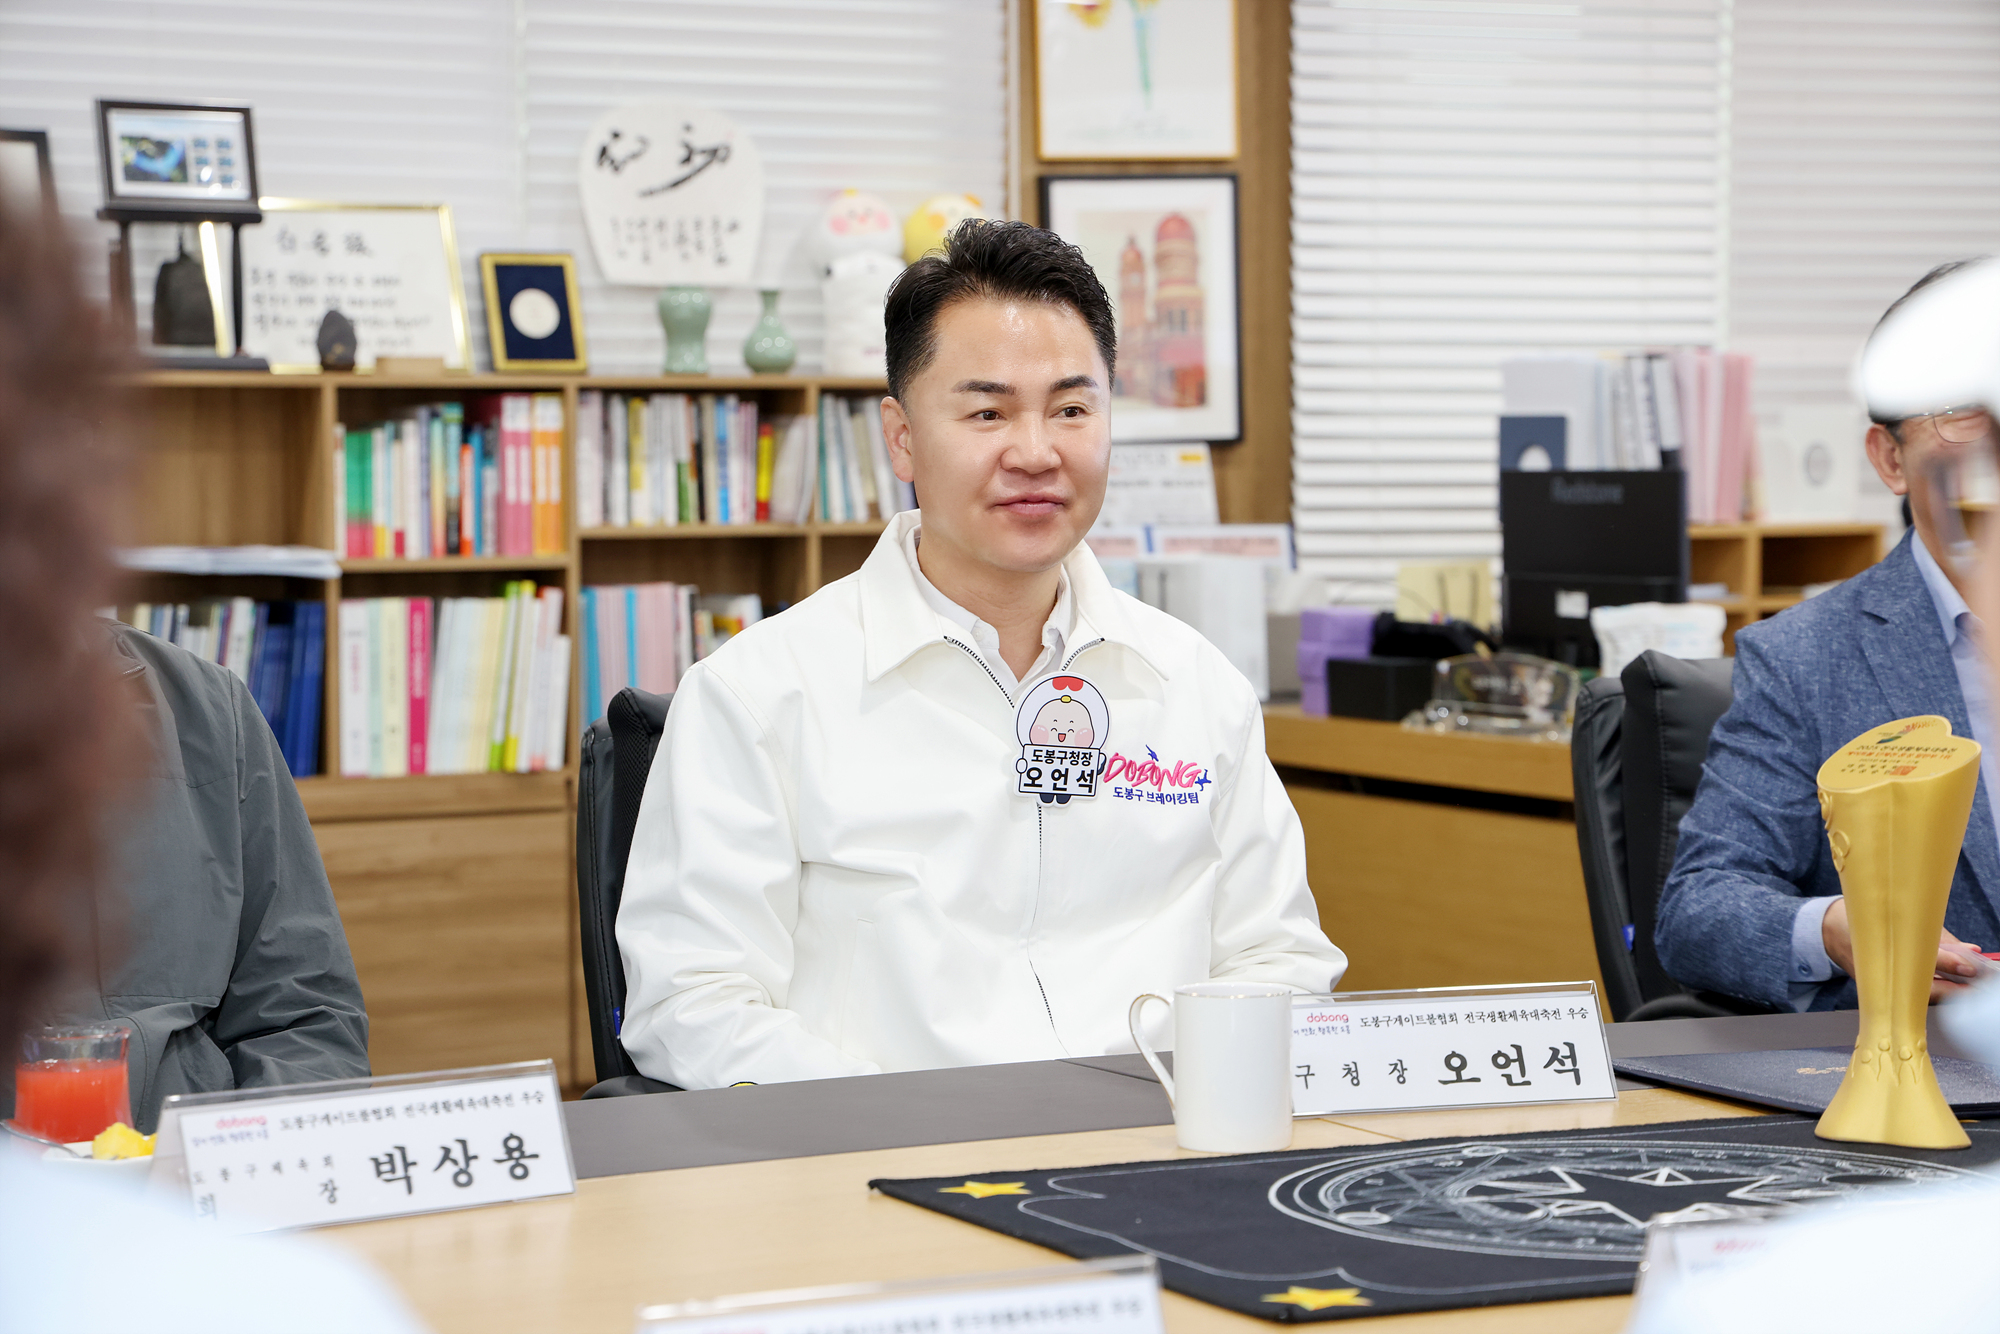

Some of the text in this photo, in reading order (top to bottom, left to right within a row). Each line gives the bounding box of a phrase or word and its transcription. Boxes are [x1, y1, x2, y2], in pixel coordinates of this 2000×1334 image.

[1031, 749, 1093, 767] 도봉구청장
[1103, 752, 1202, 792] DOBONG
[1113, 787, 1200, 806] 도봉구 브레이킹팀
[1306, 1012, 1349, 1024] dobong
[1360, 1006, 1590, 1029] 도봉구게이트볼협회 전국생활체육대축전 우승
[1438, 1041, 1582, 1086] 오언석
[279, 1089, 545, 1131] 도봉구게이트볼협회 전국생활체육대축전 우승
[215, 1114, 267, 1130] dobong
[369, 1131, 540, 1196] 박상용
